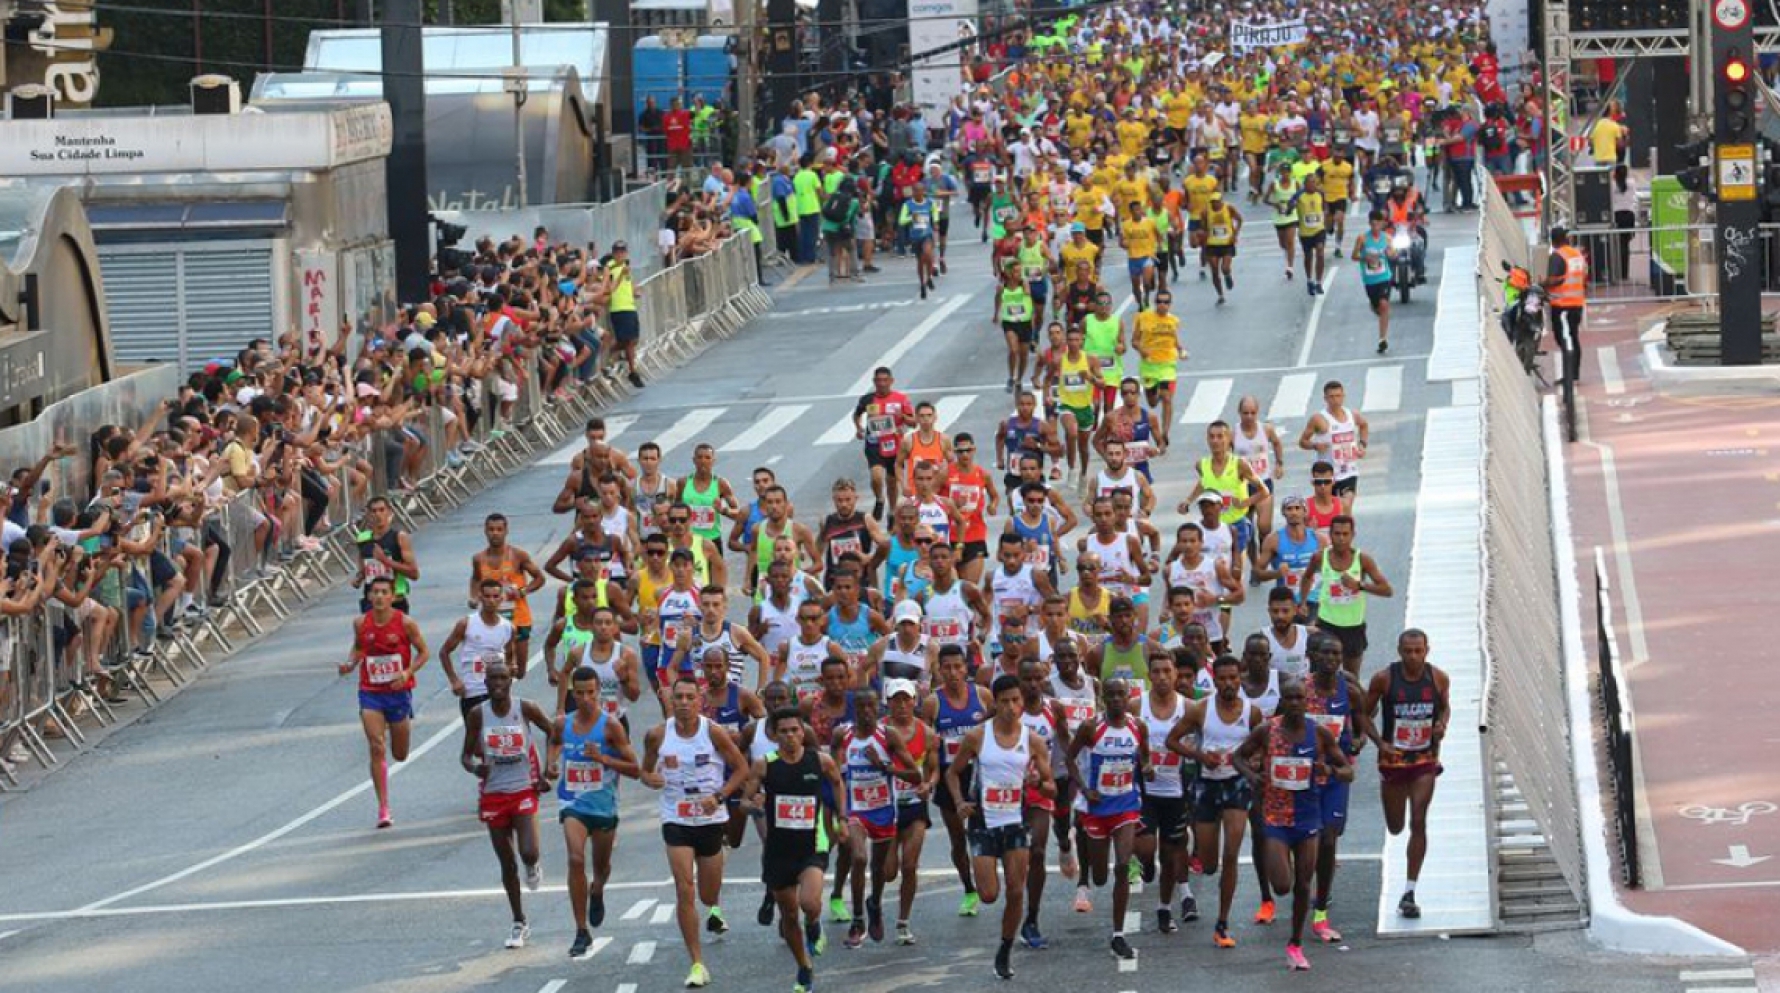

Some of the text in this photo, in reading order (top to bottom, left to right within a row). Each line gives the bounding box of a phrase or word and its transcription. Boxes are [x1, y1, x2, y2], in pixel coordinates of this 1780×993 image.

[55, 135, 115, 146] Mantenha
[30, 148, 144, 161] Sua Cidade Limpa
[664, 599, 690, 608] FILA
[1073, 707, 1087, 719] 40
[1104, 737, 1134, 748] FILA
[789, 805, 805, 819] 44
